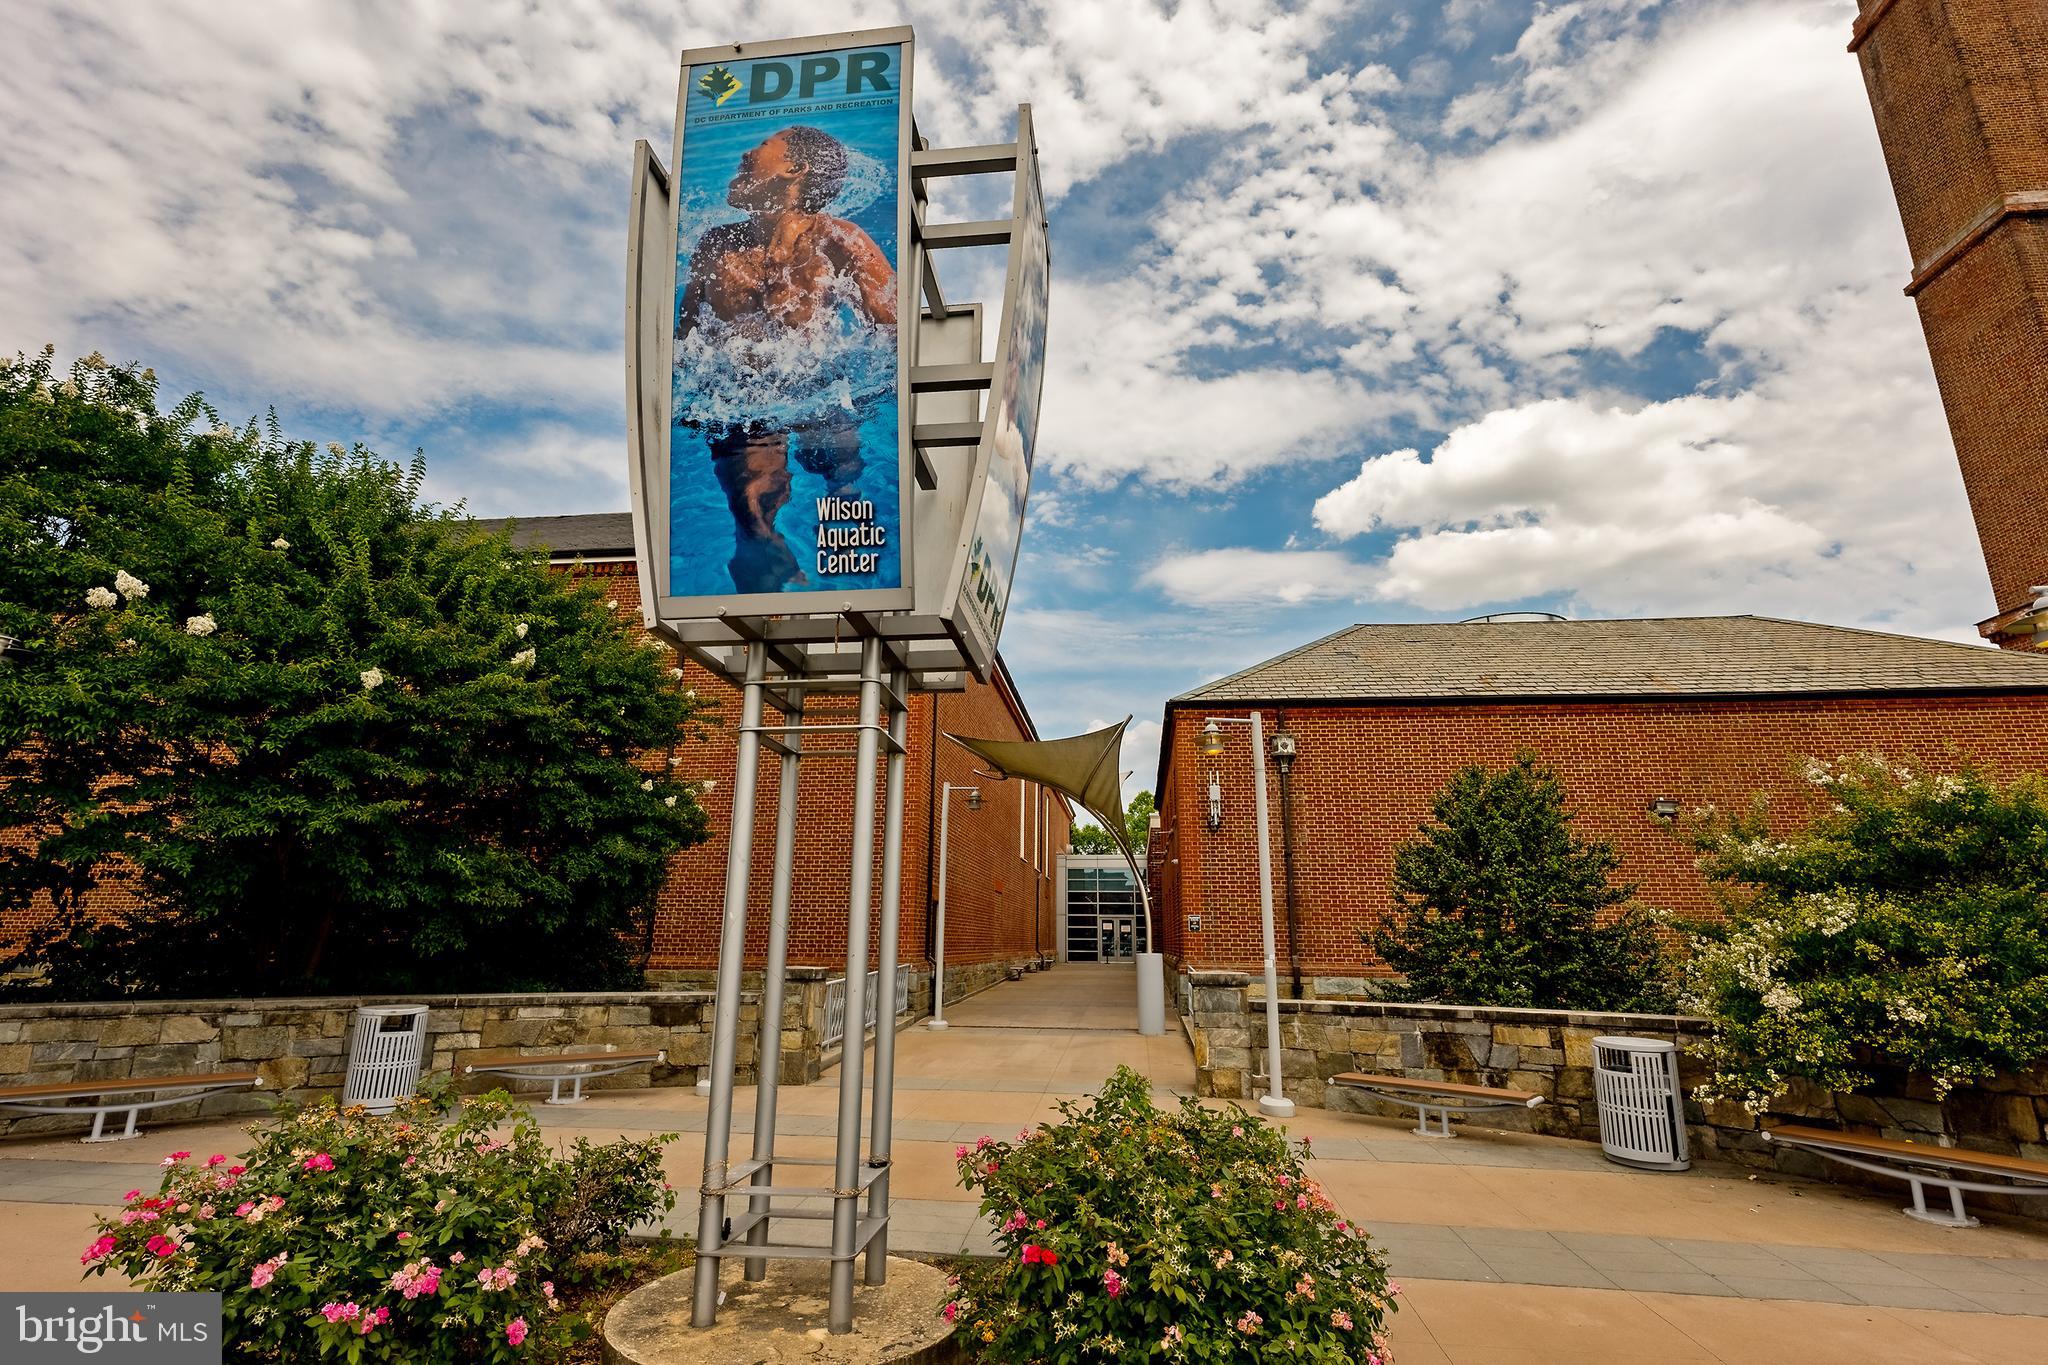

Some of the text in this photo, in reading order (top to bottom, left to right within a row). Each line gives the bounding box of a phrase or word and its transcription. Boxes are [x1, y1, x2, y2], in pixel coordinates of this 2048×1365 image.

[749, 51, 893, 103] DPR
[694, 97, 894, 124] DC DEPARTMENT OF PARKS AND RECREATION
[816, 496, 873, 521] Wilson
[816, 521, 886, 552] Aquatic
[816, 549, 879, 574] Center
